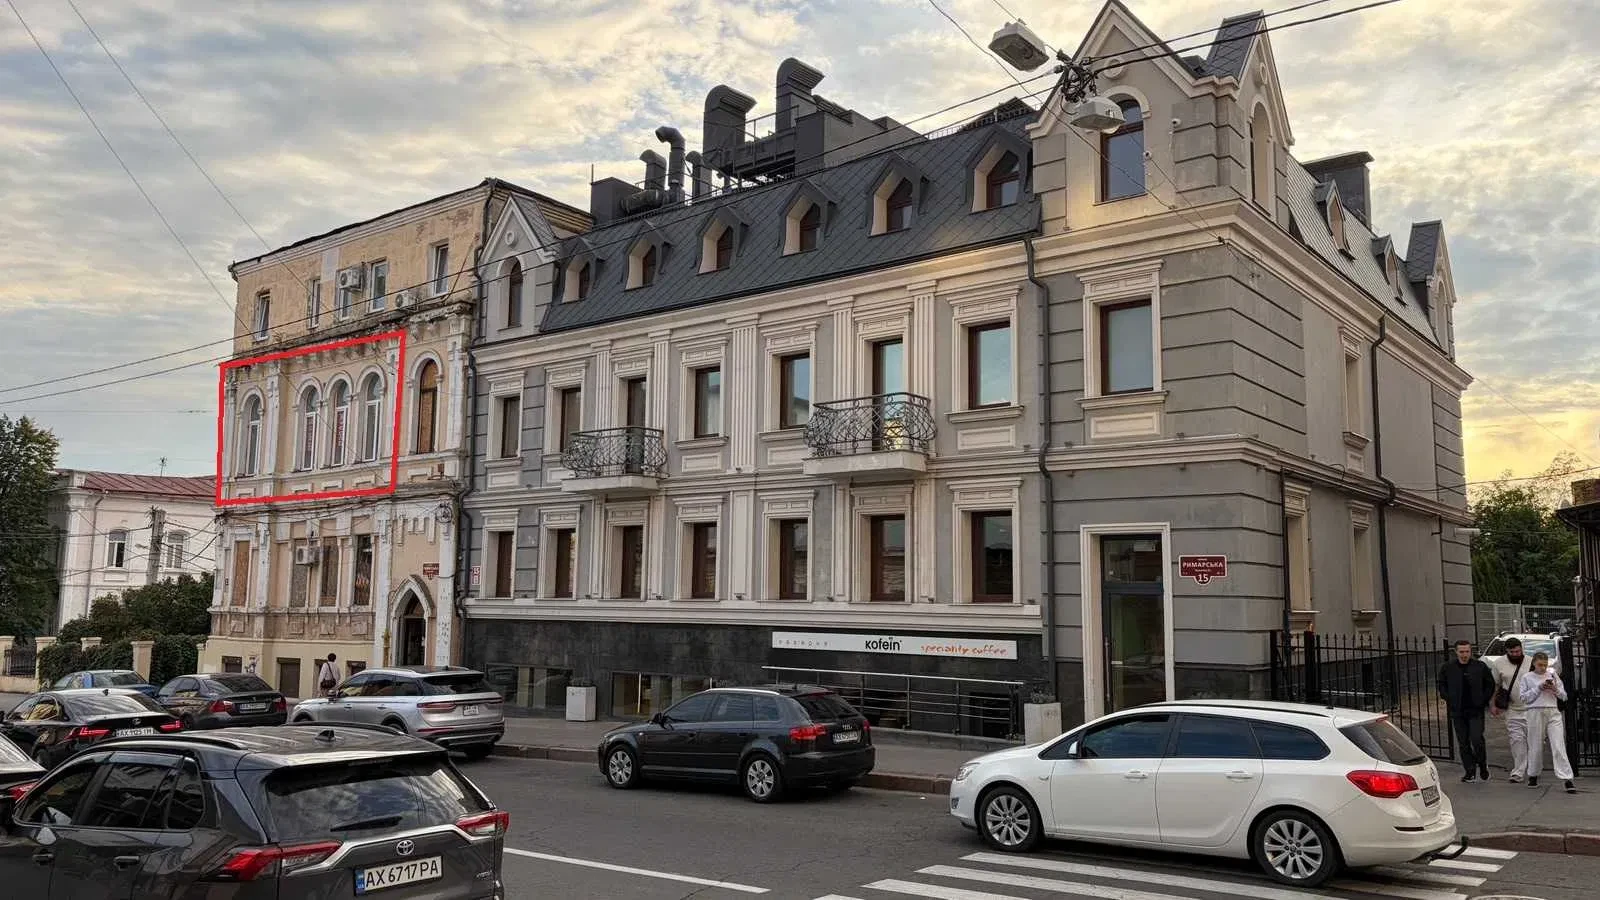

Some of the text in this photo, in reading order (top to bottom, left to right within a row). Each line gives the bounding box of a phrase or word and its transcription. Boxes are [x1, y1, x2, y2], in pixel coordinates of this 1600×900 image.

[1198, 574, 1209, 582] 15
[366, 860, 438, 888] AX 6717 PA
